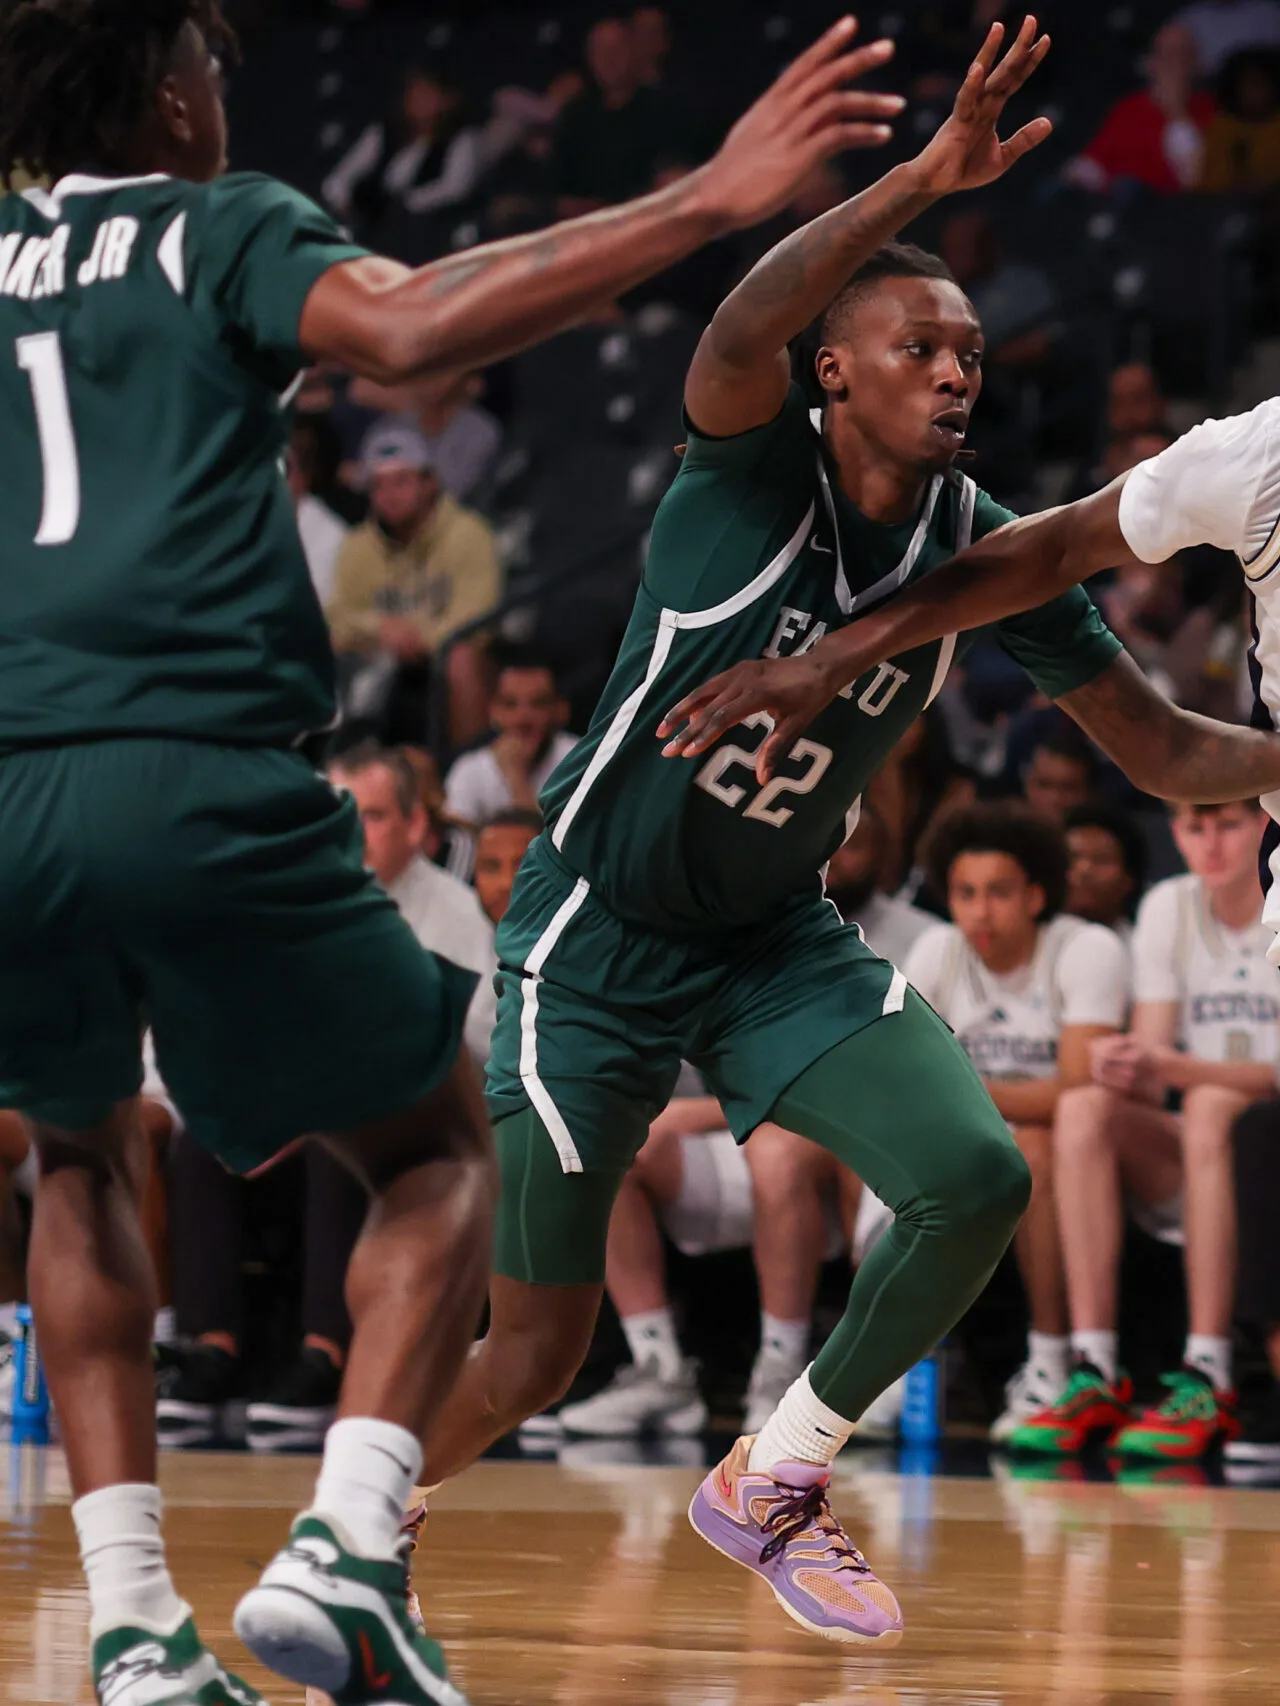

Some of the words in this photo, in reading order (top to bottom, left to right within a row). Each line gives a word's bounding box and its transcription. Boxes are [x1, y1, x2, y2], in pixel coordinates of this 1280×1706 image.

[77, 215, 139, 286] JR
[15, 331, 80, 545] 1
[694, 710, 833, 828] 22
